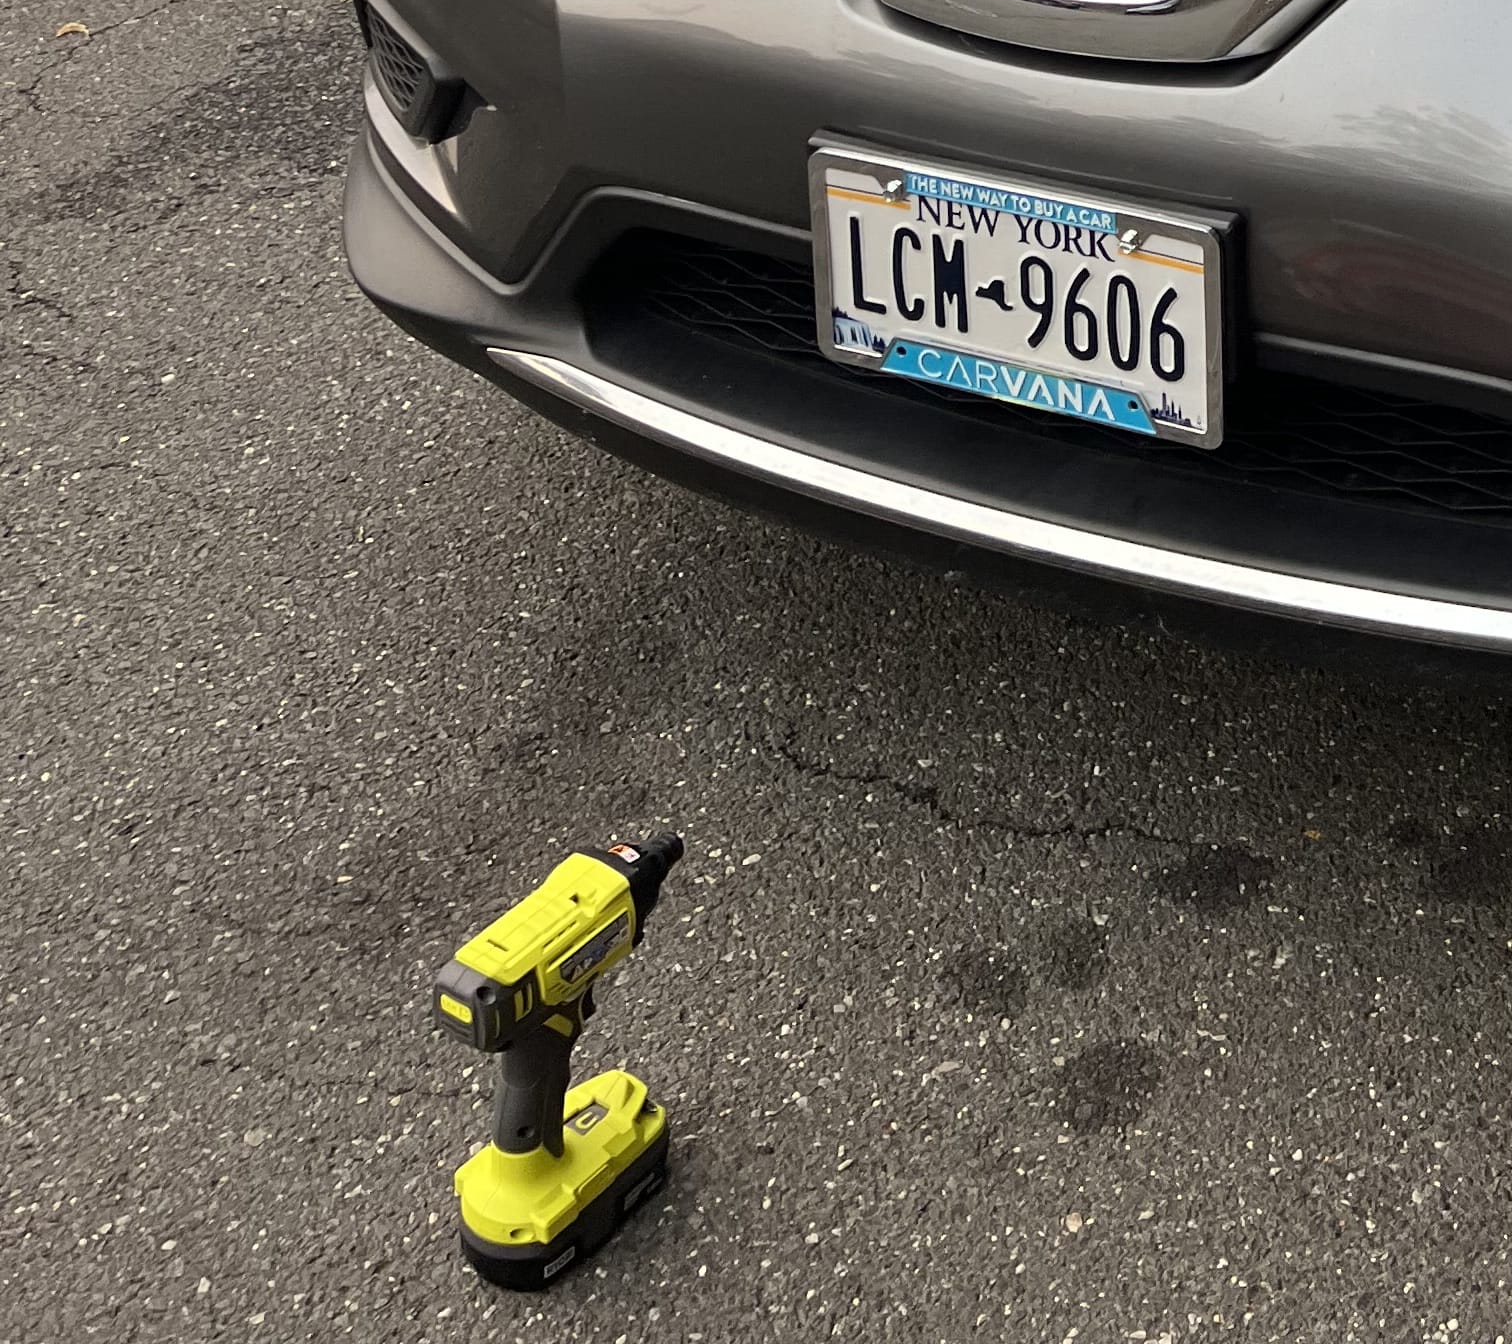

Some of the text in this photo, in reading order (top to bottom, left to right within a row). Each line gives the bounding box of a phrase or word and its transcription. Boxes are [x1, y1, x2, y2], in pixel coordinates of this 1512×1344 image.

[911, 175, 1112, 228] THE NEW WAY TO BUY A CAR
[916, 196, 1116, 263] NEW YORK
[1019, 255, 1185, 383] 9606
[917, 349, 1116, 421] CARVANA
